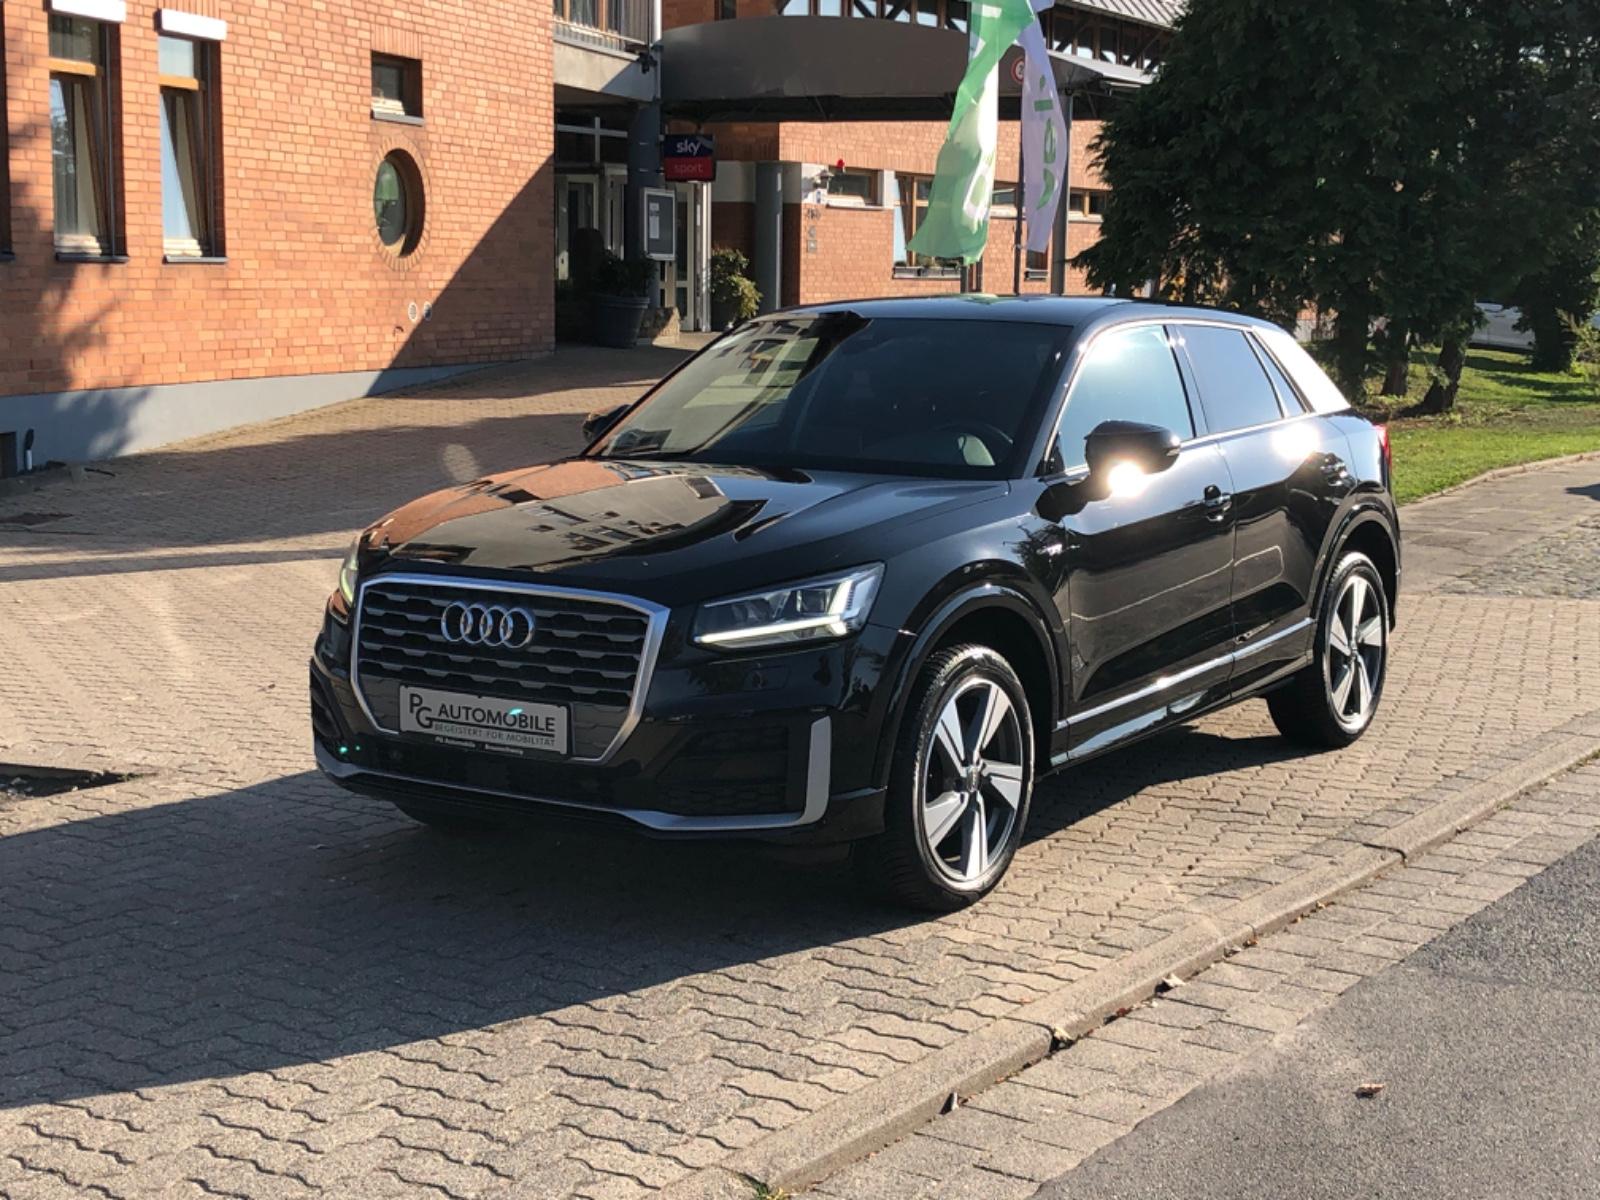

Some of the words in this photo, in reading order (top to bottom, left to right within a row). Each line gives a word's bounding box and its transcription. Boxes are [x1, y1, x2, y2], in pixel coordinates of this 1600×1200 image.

[676, 138, 701, 156] sky
[674, 163, 704, 175] sport
[438, 703, 556, 732] AUTOMOBILE
[434, 722, 483, 738] BEGEISTERT
